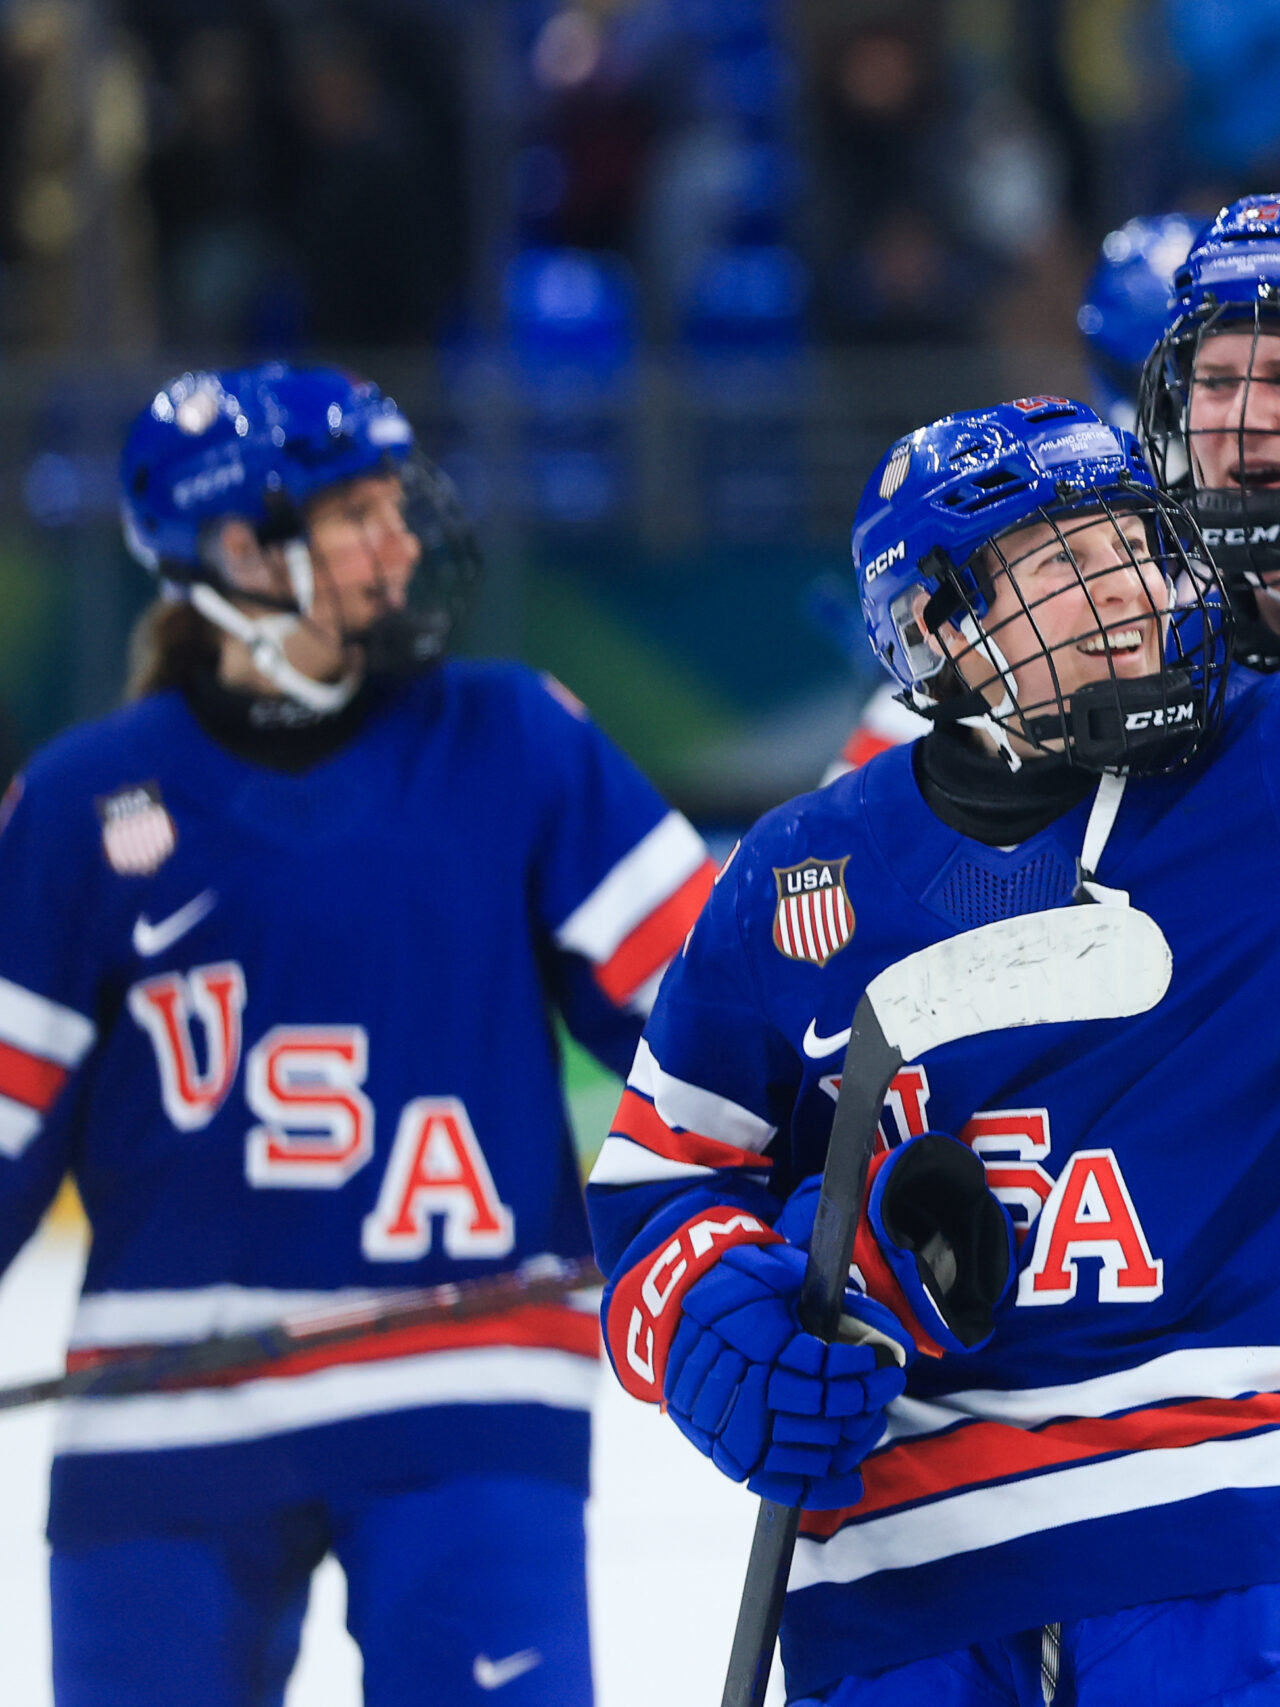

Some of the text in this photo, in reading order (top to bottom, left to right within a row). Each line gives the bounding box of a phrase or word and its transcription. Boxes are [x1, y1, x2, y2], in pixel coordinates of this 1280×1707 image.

[1038, 434, 1076, 454] MILANO
[1201, 523, 1280, 546] CCM
[865, 540, 905, 583] CCM
[1124, 701, 1195, 731] CCM
[787, 865, 834, 894] USA
[128, 959, 517, 1264] USA
[626, 1214, 765, 1385] CCM
